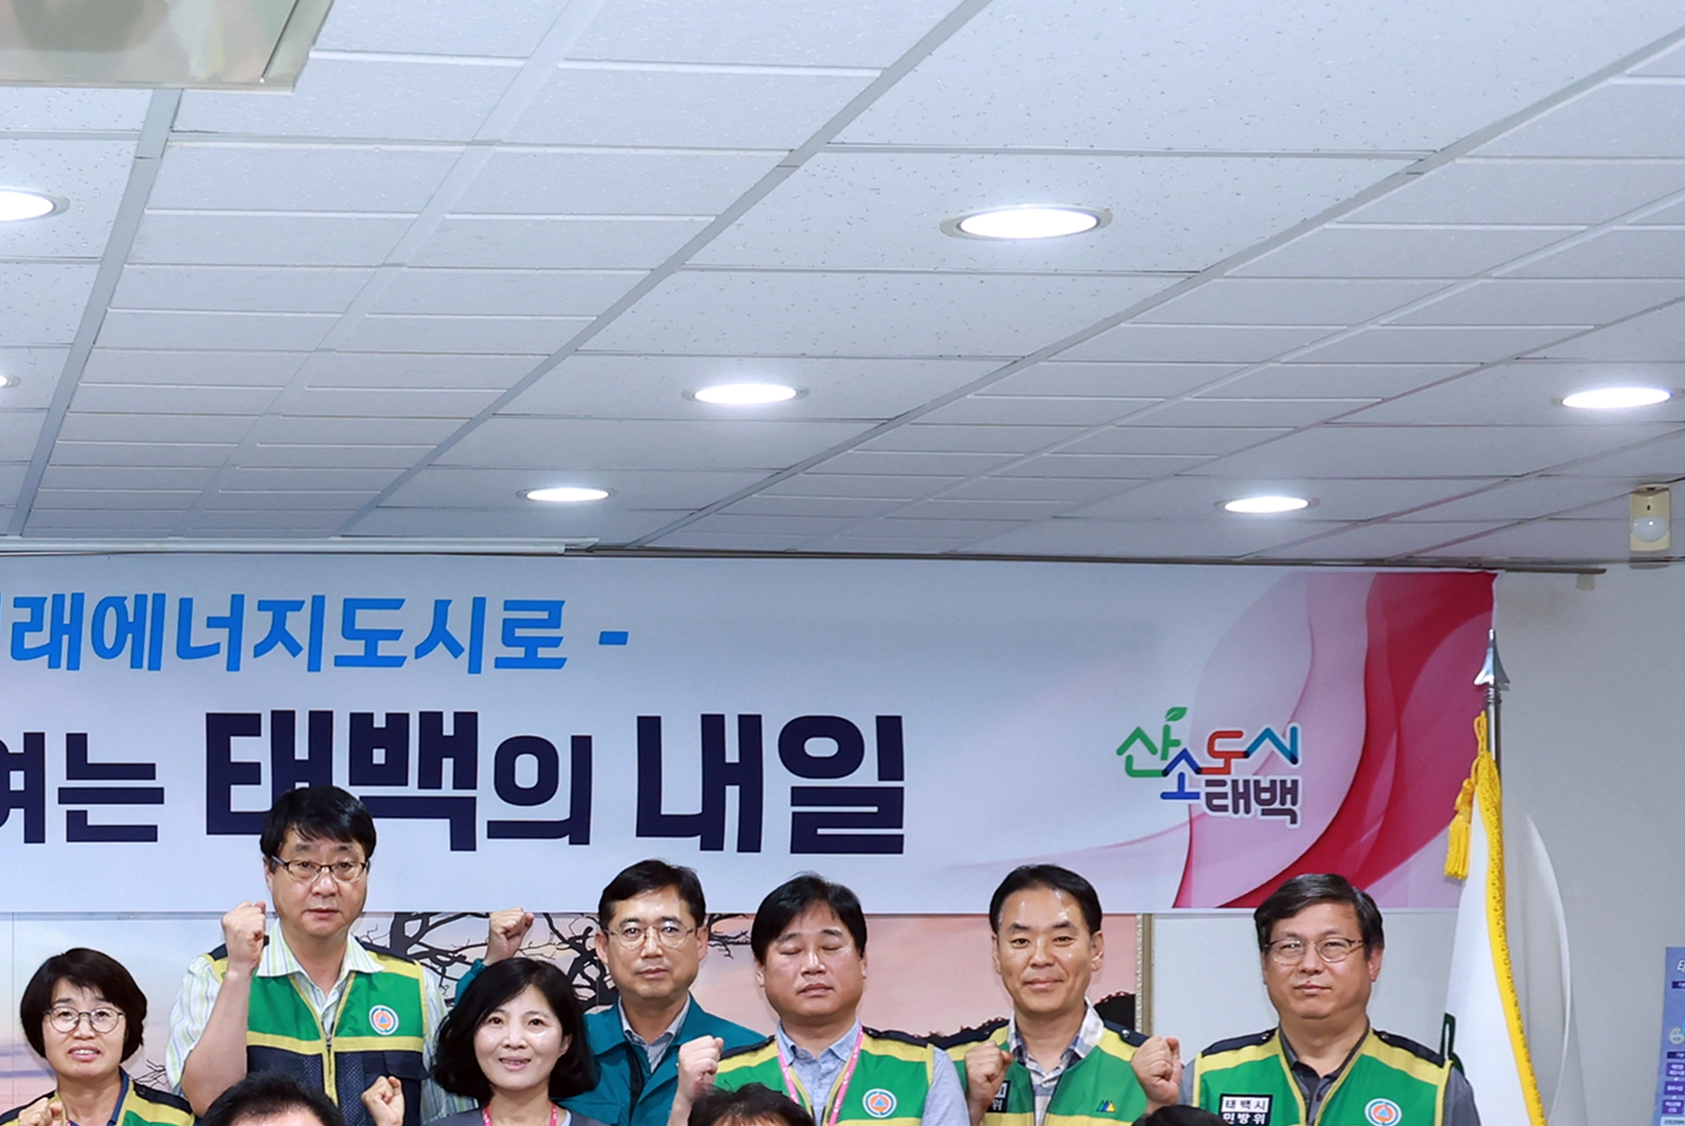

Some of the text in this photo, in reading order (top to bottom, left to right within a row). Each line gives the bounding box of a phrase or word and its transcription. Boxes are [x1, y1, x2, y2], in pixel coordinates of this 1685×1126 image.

[206, 710, 592, 852] 태백의
[635, 713, 905, 855] 내일
[1204, 778, 1299, 825] 태백
[1222, 1112, 1266, 1125] 민방위
